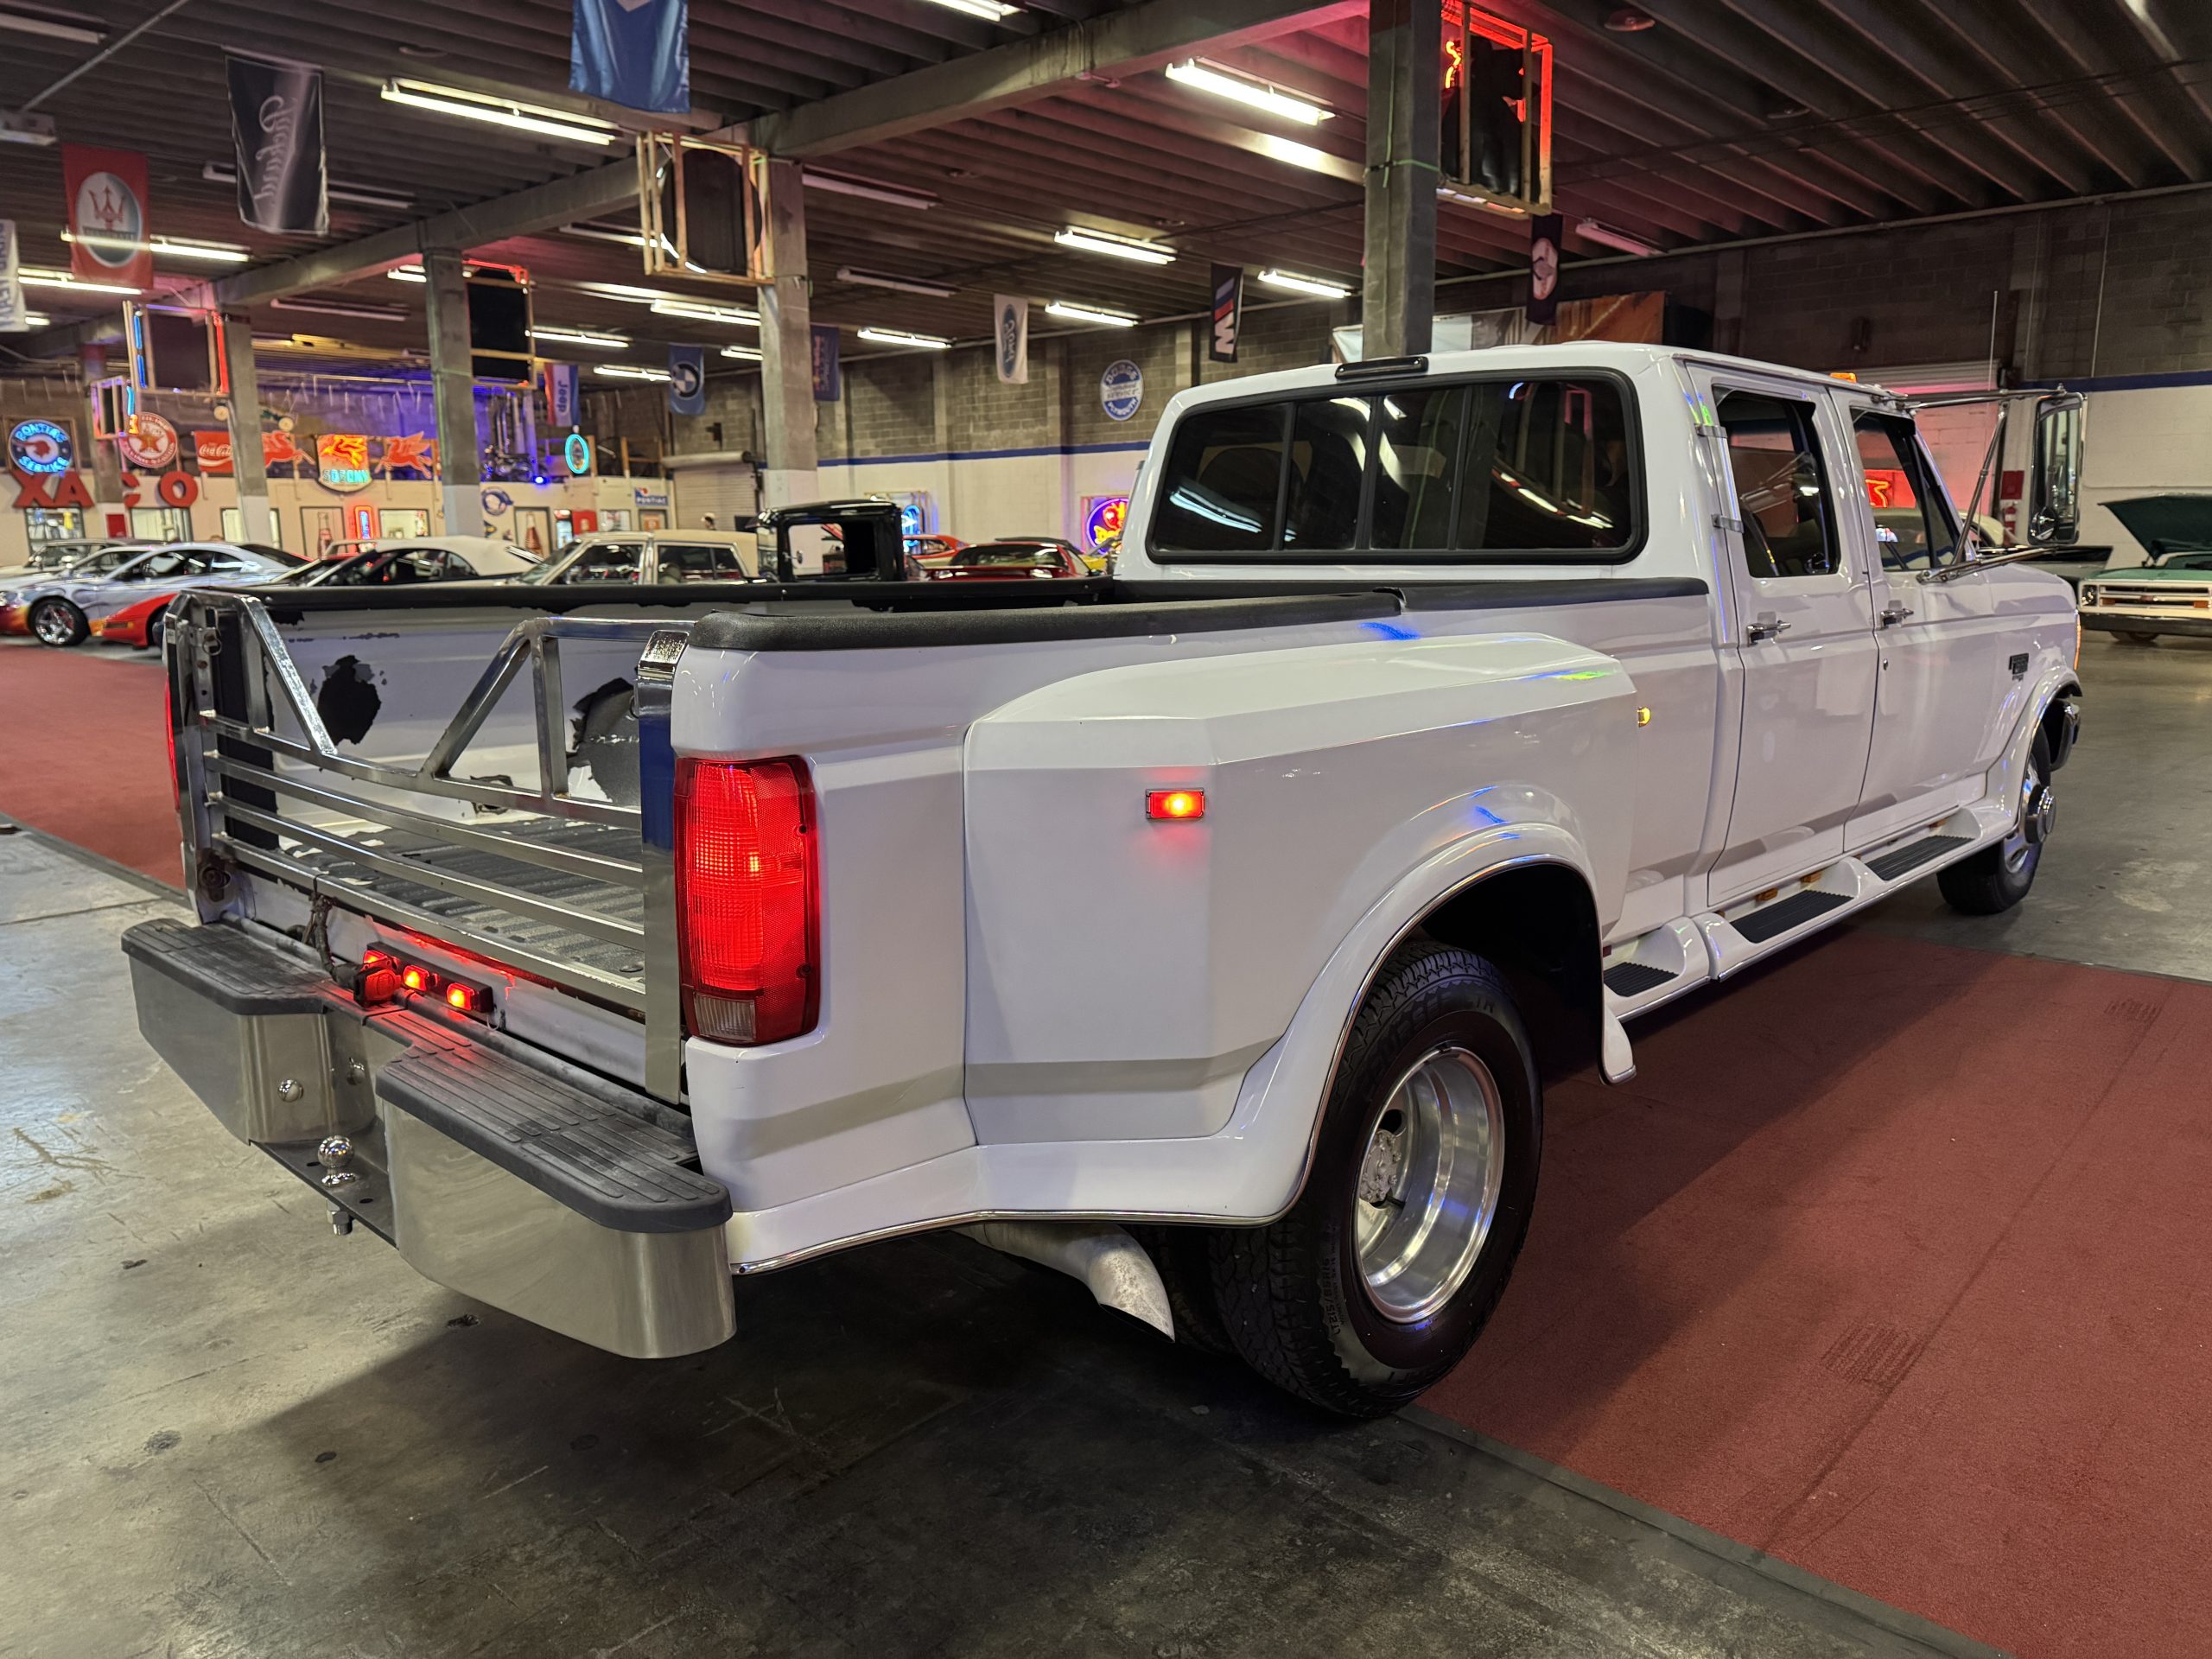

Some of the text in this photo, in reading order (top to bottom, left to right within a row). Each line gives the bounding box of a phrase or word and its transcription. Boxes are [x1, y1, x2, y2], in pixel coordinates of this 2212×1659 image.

[1106, 364, 1138, 385] DODGE
[557, 383, 569, 414] Jeep
[1107, 397, 1139, 416] PLYMOUTH
[15, 423, 69, 443] PONTIAC
[18, 455, 70, 473] SERVICE
